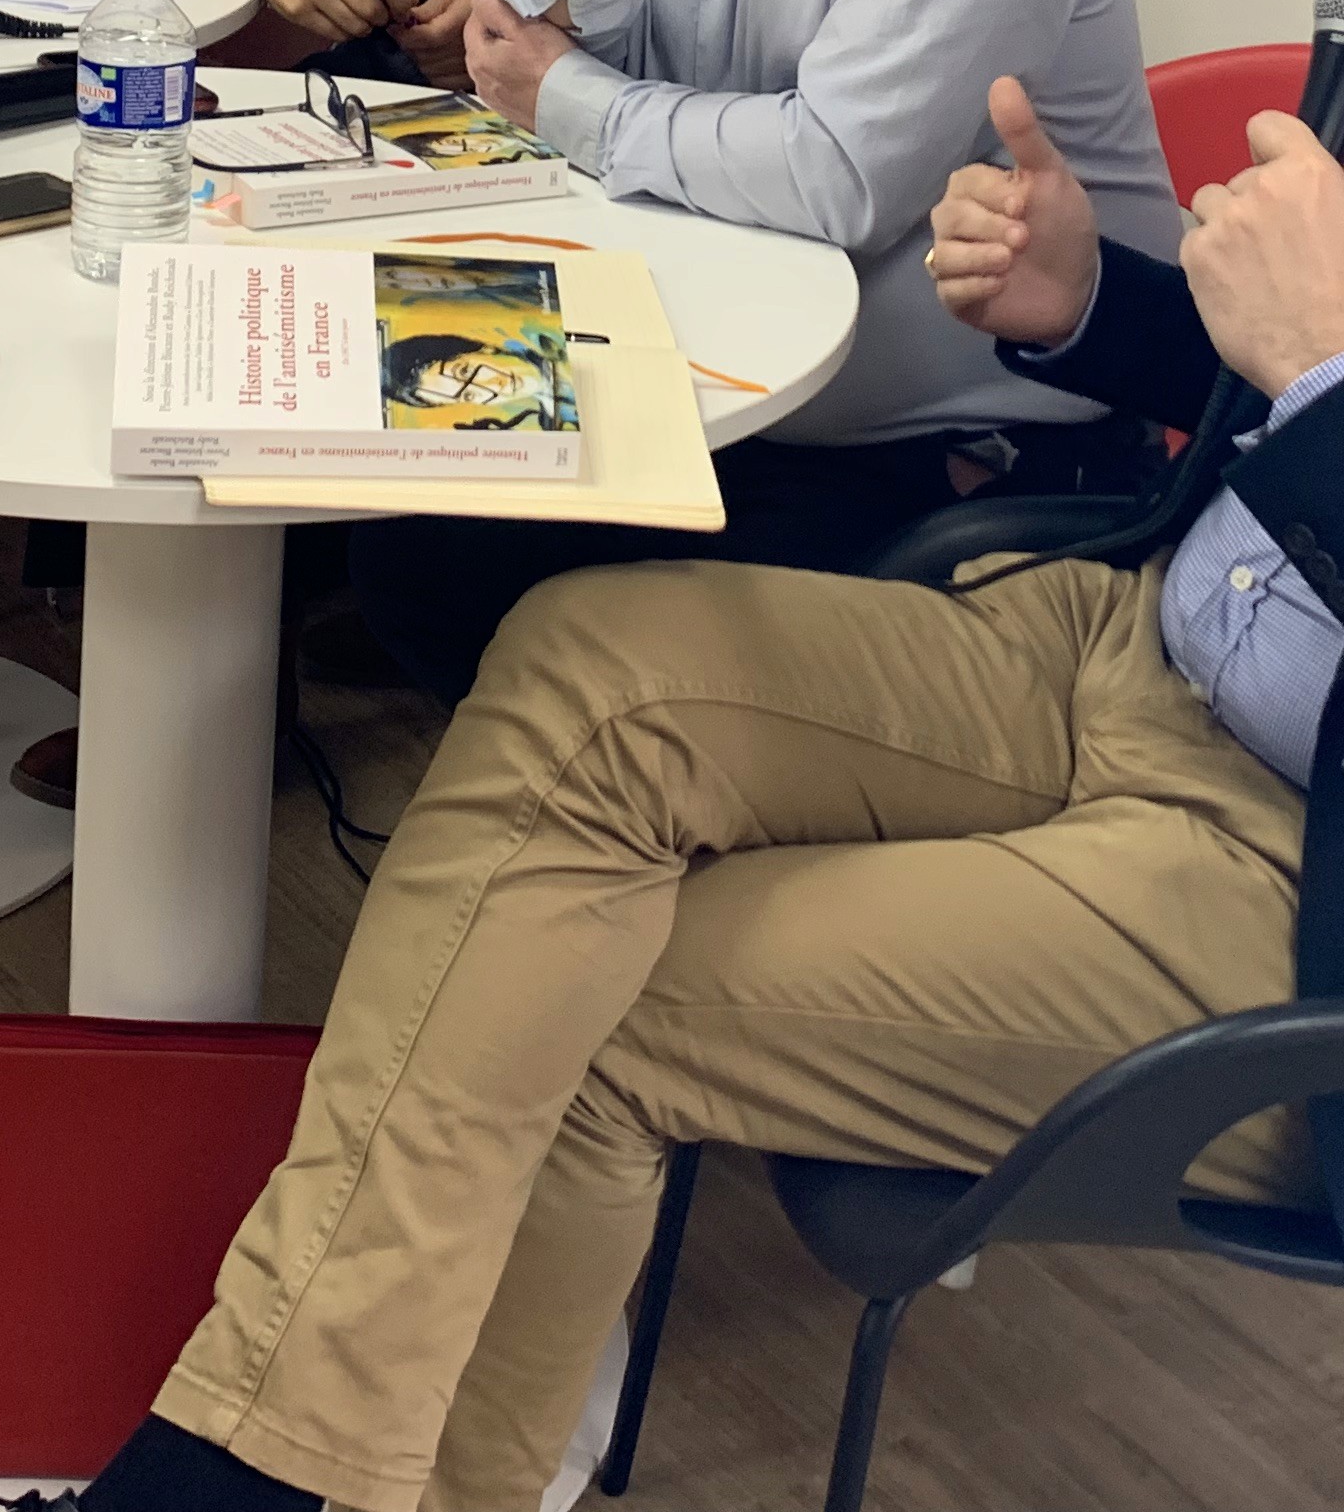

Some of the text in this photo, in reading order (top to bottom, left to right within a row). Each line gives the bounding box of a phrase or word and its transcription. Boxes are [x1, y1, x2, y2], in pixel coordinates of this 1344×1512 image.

[238, 267, 269, 406] Histoire politique
[273, 264, 297, 412] de l'antisémitisme
[307, 301, 331, 378] en France
[258, 446, 529, 461] Histoire politique de l'antisémitisme en France
